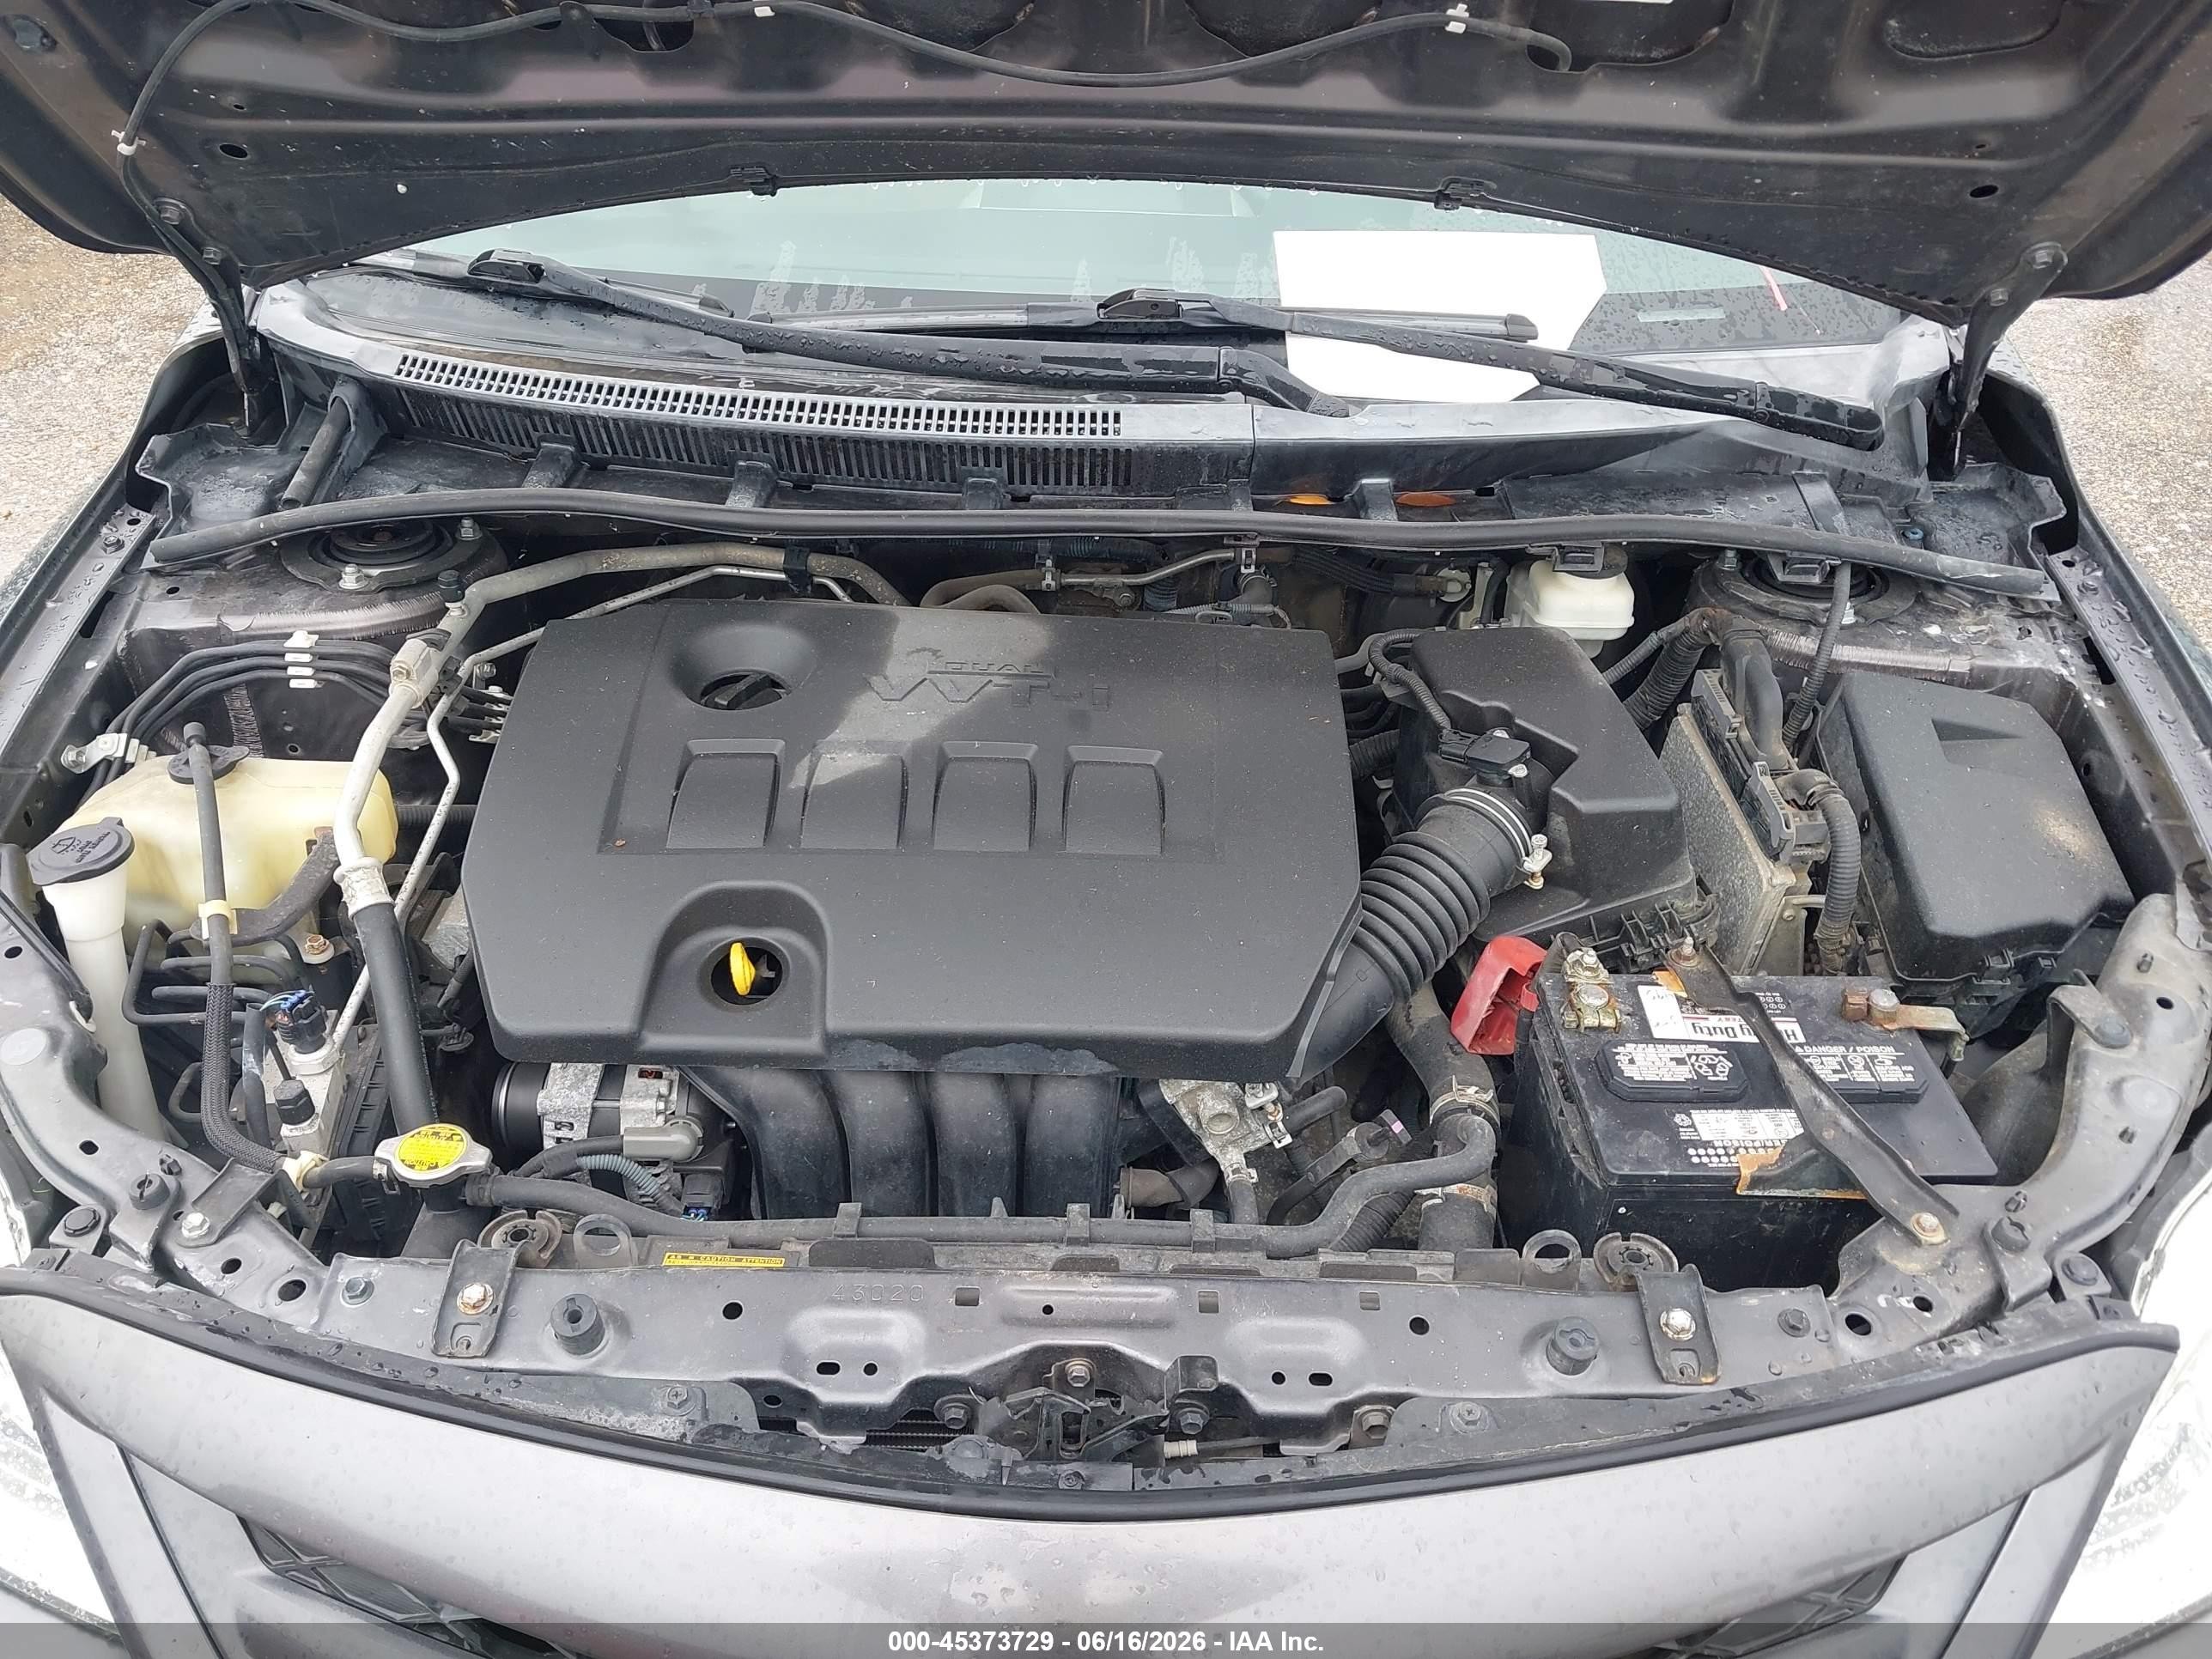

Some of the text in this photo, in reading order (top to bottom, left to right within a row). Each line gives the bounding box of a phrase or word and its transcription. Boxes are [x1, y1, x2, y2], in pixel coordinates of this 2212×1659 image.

[1692, 1023, 1739, 1038] Duty
[1803, 1045, 1847, 1054] DANGER
[830, 1283, 925, 1303] 43020
